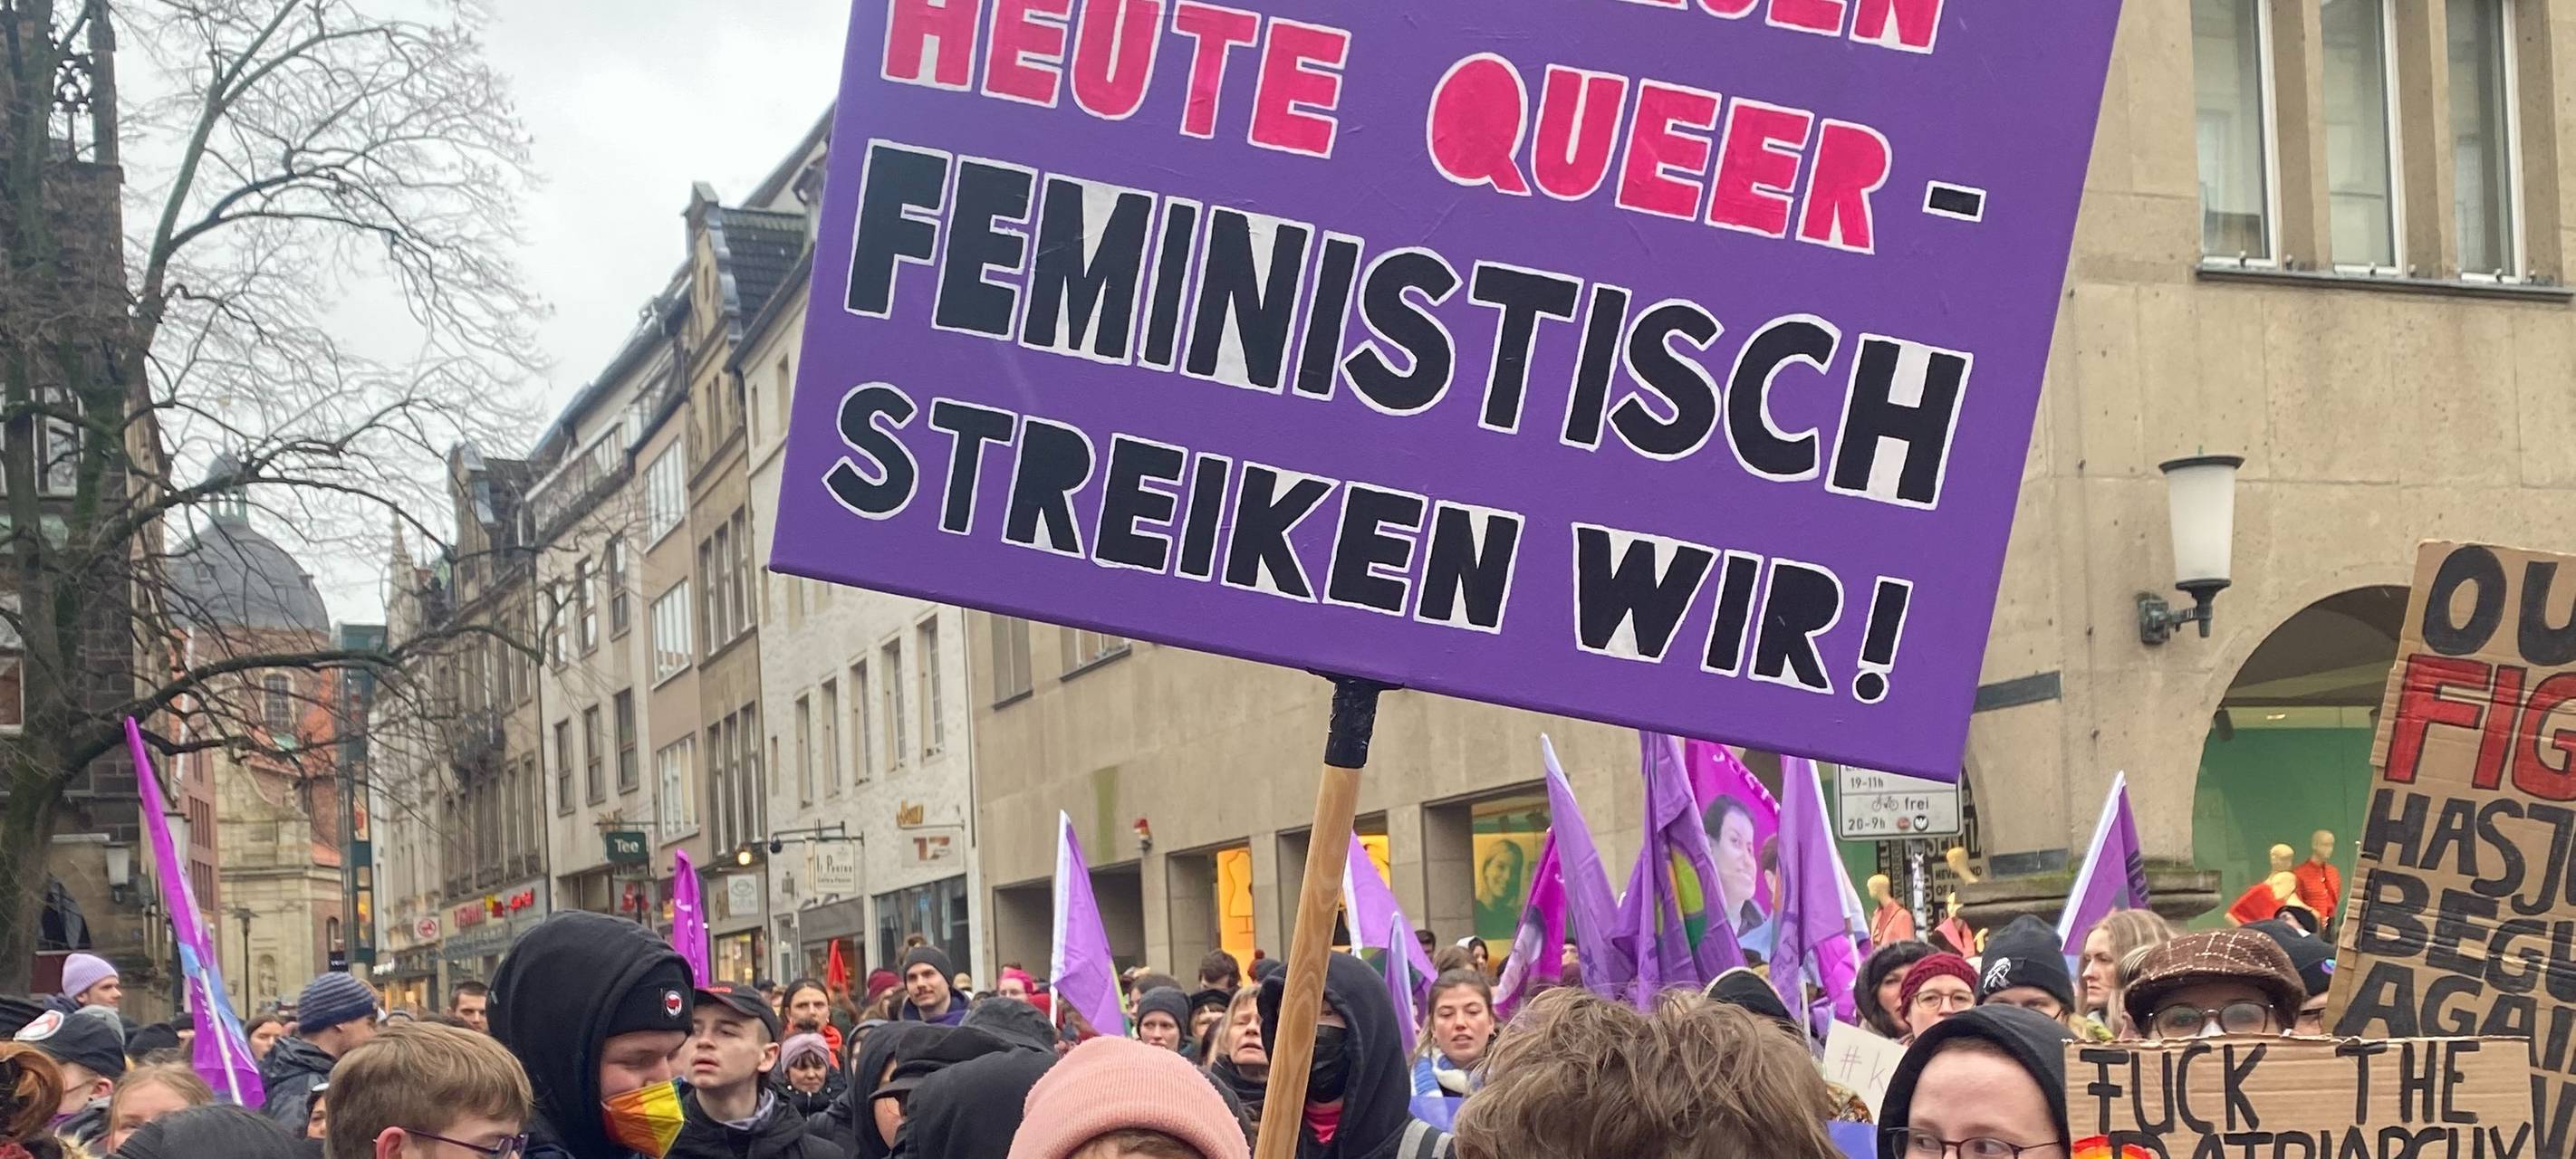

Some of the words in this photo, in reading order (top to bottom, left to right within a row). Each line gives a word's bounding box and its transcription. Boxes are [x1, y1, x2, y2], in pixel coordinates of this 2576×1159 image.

[881, 0, 1351, 158] HEUTE
[844, 139, 1974, 511] FEMINISTISCH
[822, 382, 1525, 636] STREIKEN
[1572, 522, 1914, 704] WIR!
[614, 838, 639, 854] Tee
[1848, 817, 1886, 831] 20-9h
[1904, 796, 1929, 810] frei
[2331, 961, 2576, 1072] AGAI
[2079, 1043, 2267, 1135] FUCK
[2335, 1040, 2480, 1125] THE
